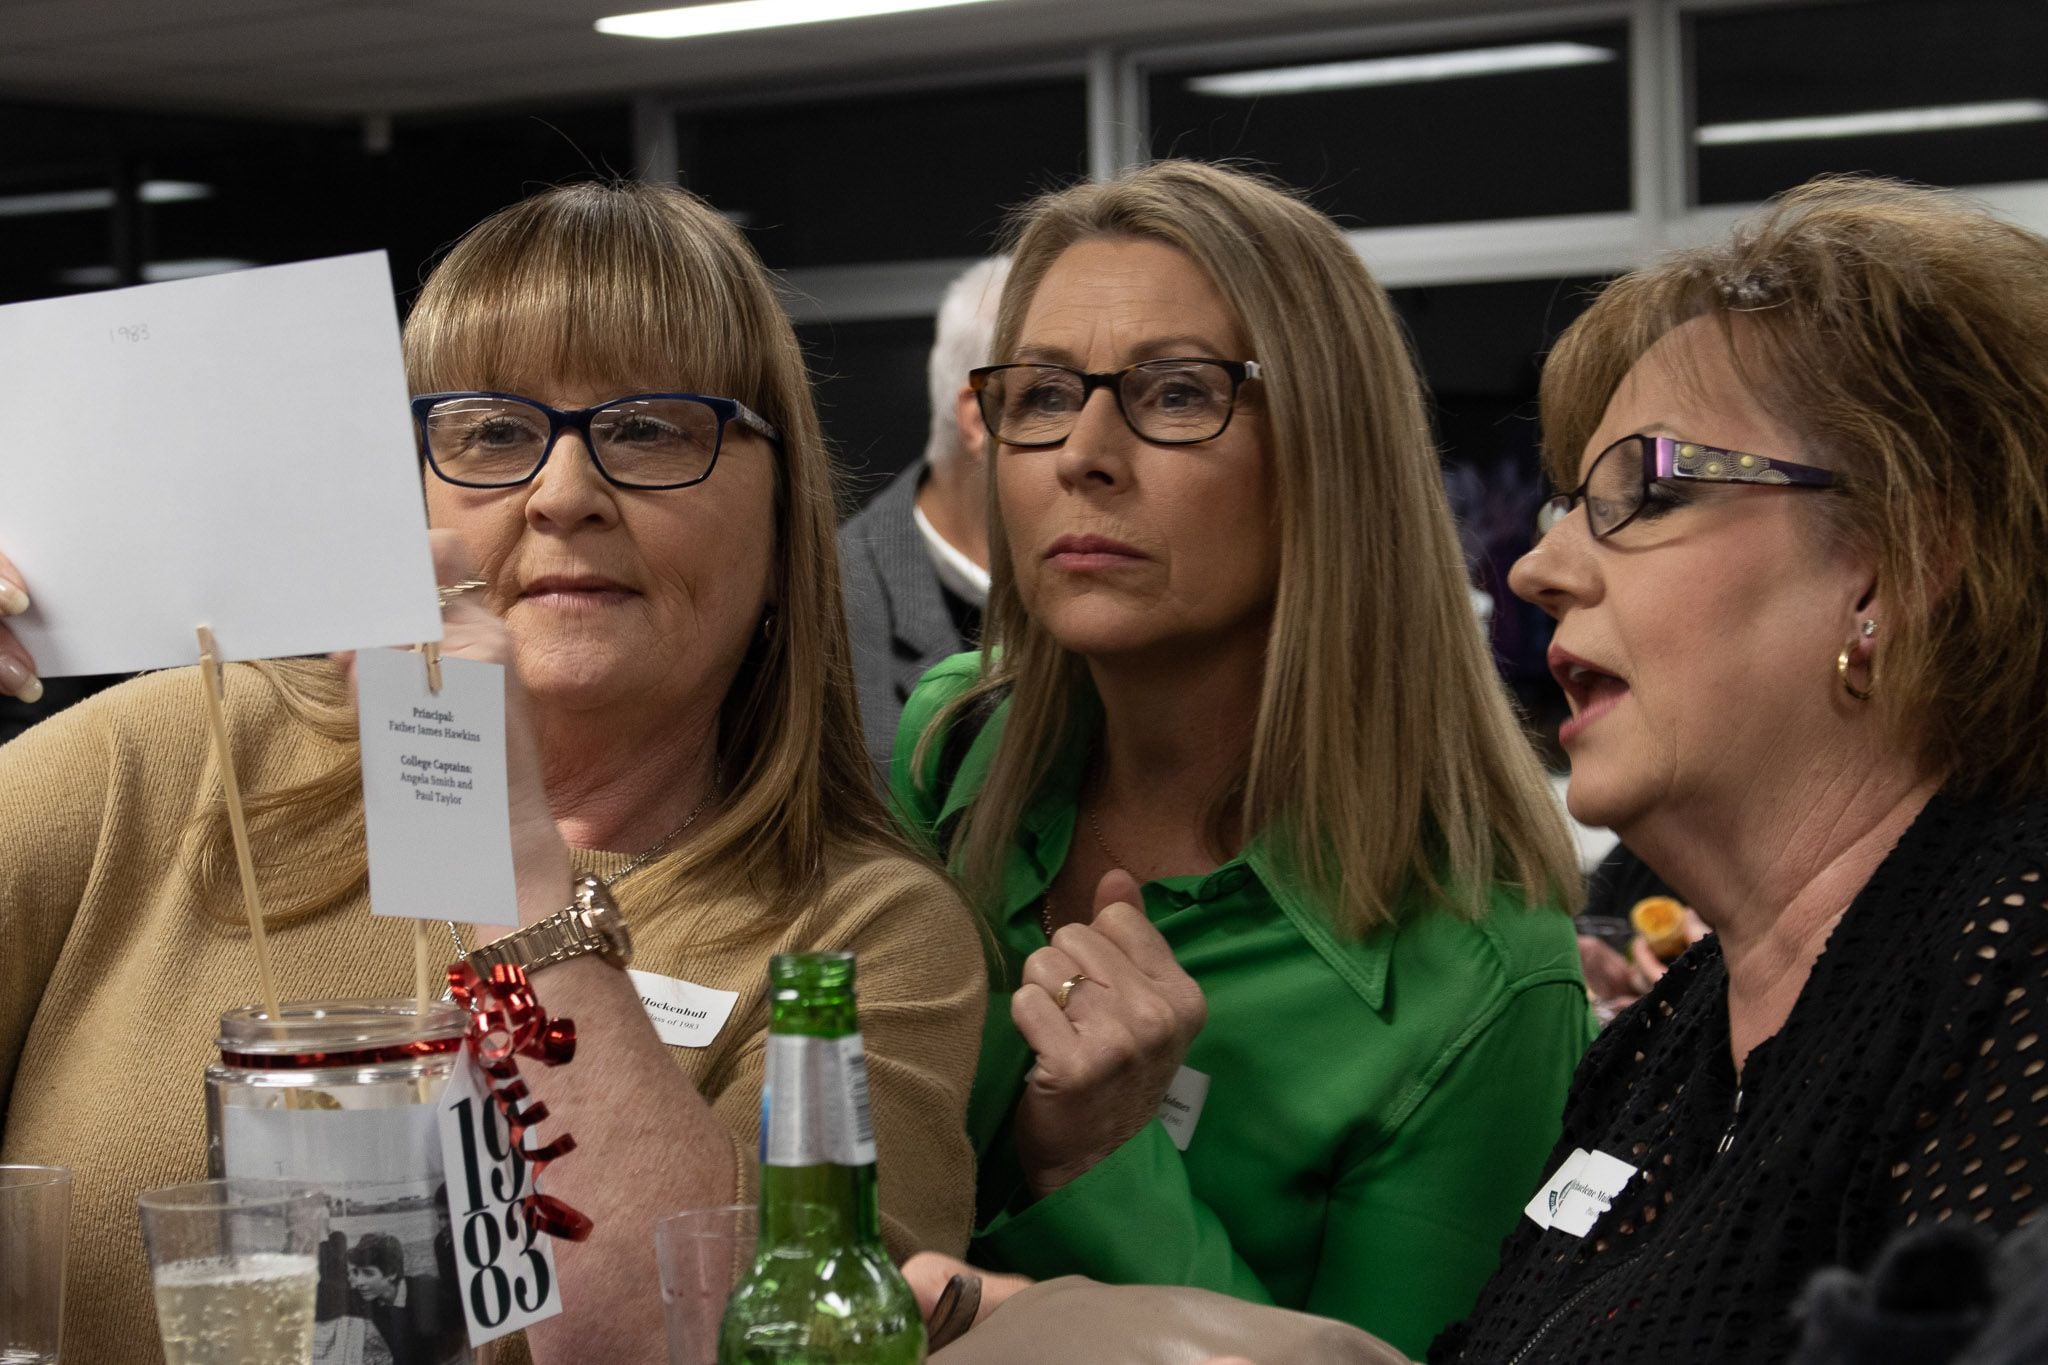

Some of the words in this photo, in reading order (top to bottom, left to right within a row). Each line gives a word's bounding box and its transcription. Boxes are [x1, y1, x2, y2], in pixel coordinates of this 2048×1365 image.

[413, 707, 454, 724] Principal:
[389, 720, 416, 734] Father
[417, 724, 442, 737] James
[444, 728, 481, 742] Hawkins
[400, 755, 432, 771] College
[433, 759, 473, 774] Captains:
[400, 772, 429, 786] Angela
[430, 775, 456, 788] Smith
[457, 779, 473, 790] and
[415, 789, 434, 802] Paul
[435, 791, 462, 807] Taylor
[649, 1013, 665, 1024] lass
[667, 1019, 677, 1027] of
[680, 1020, 700, 1030] 1983
[463, 1198, 551, 1329] 83
